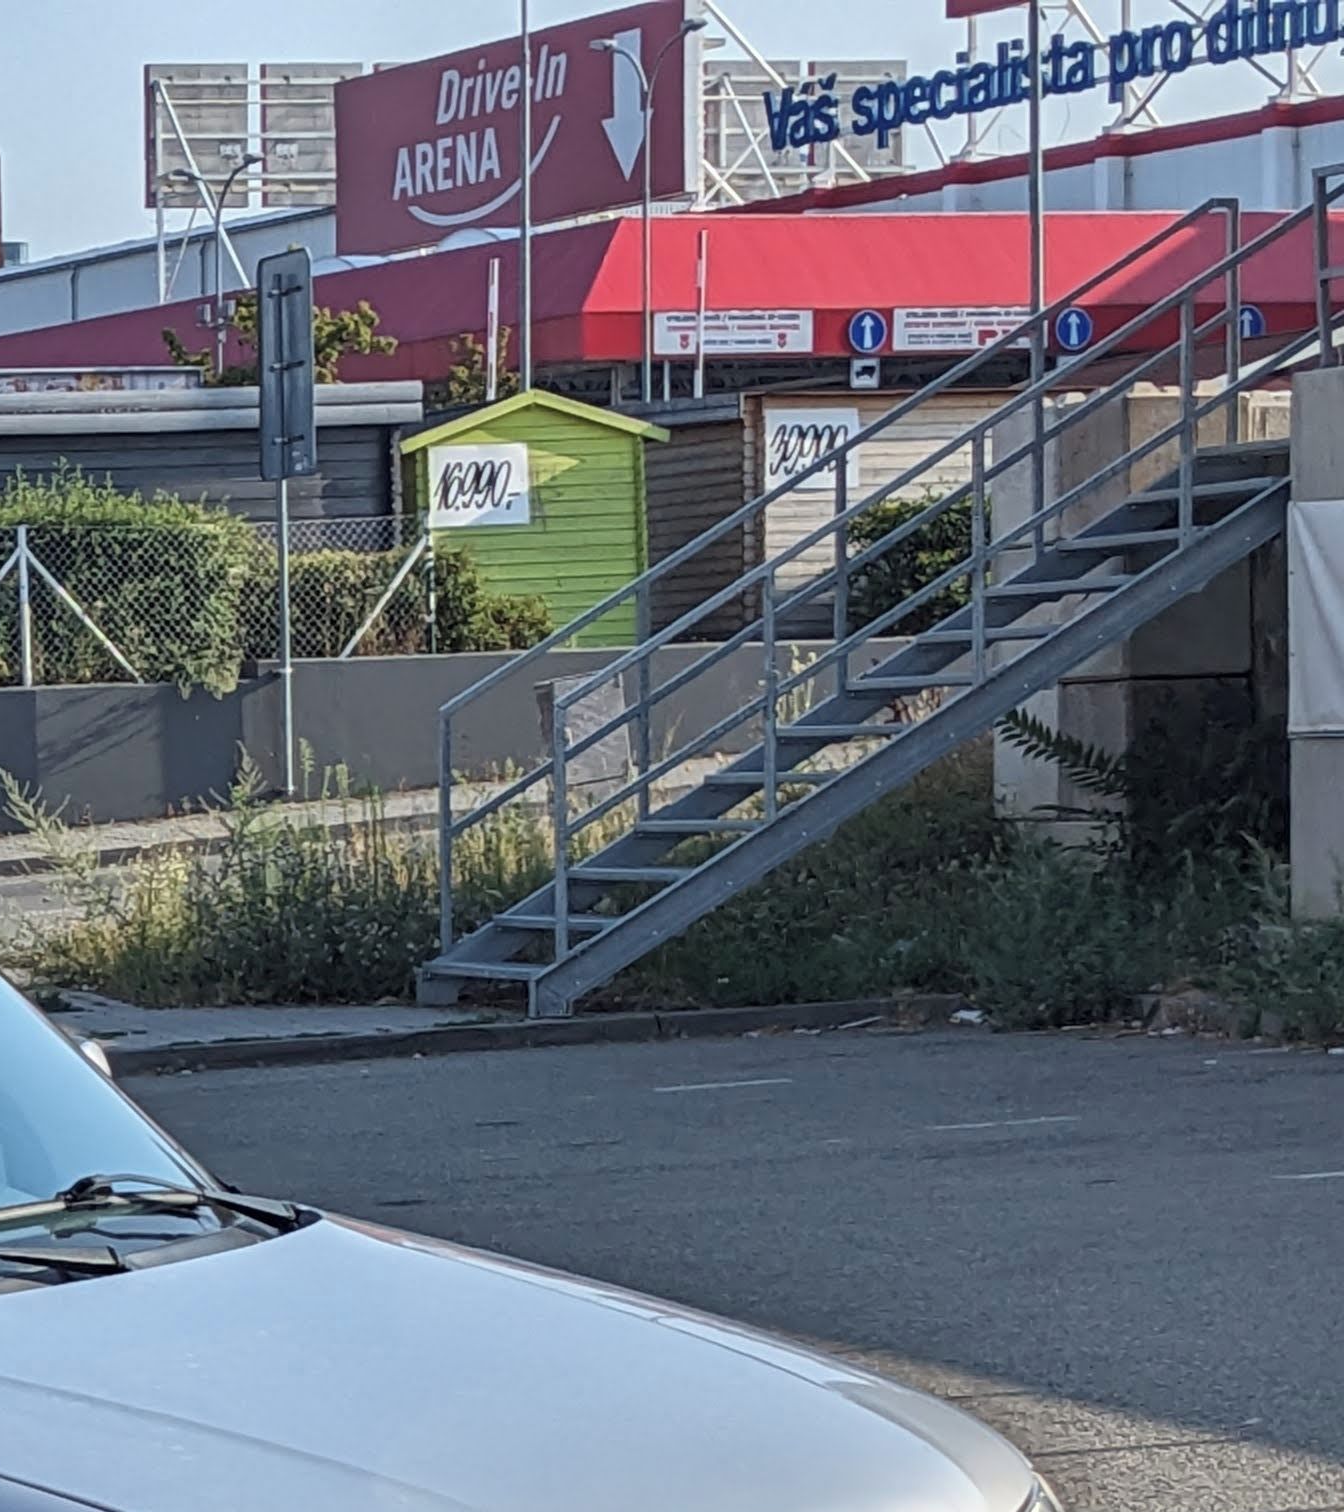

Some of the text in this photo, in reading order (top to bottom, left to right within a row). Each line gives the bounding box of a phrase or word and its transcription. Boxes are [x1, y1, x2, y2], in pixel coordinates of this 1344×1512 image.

[764, 73, 840, 151] Váš
[852, 33, 1096, 149] specialista
[1108, 20, 1192, 104] pro
[392, 127, 502, 201] ARENA
